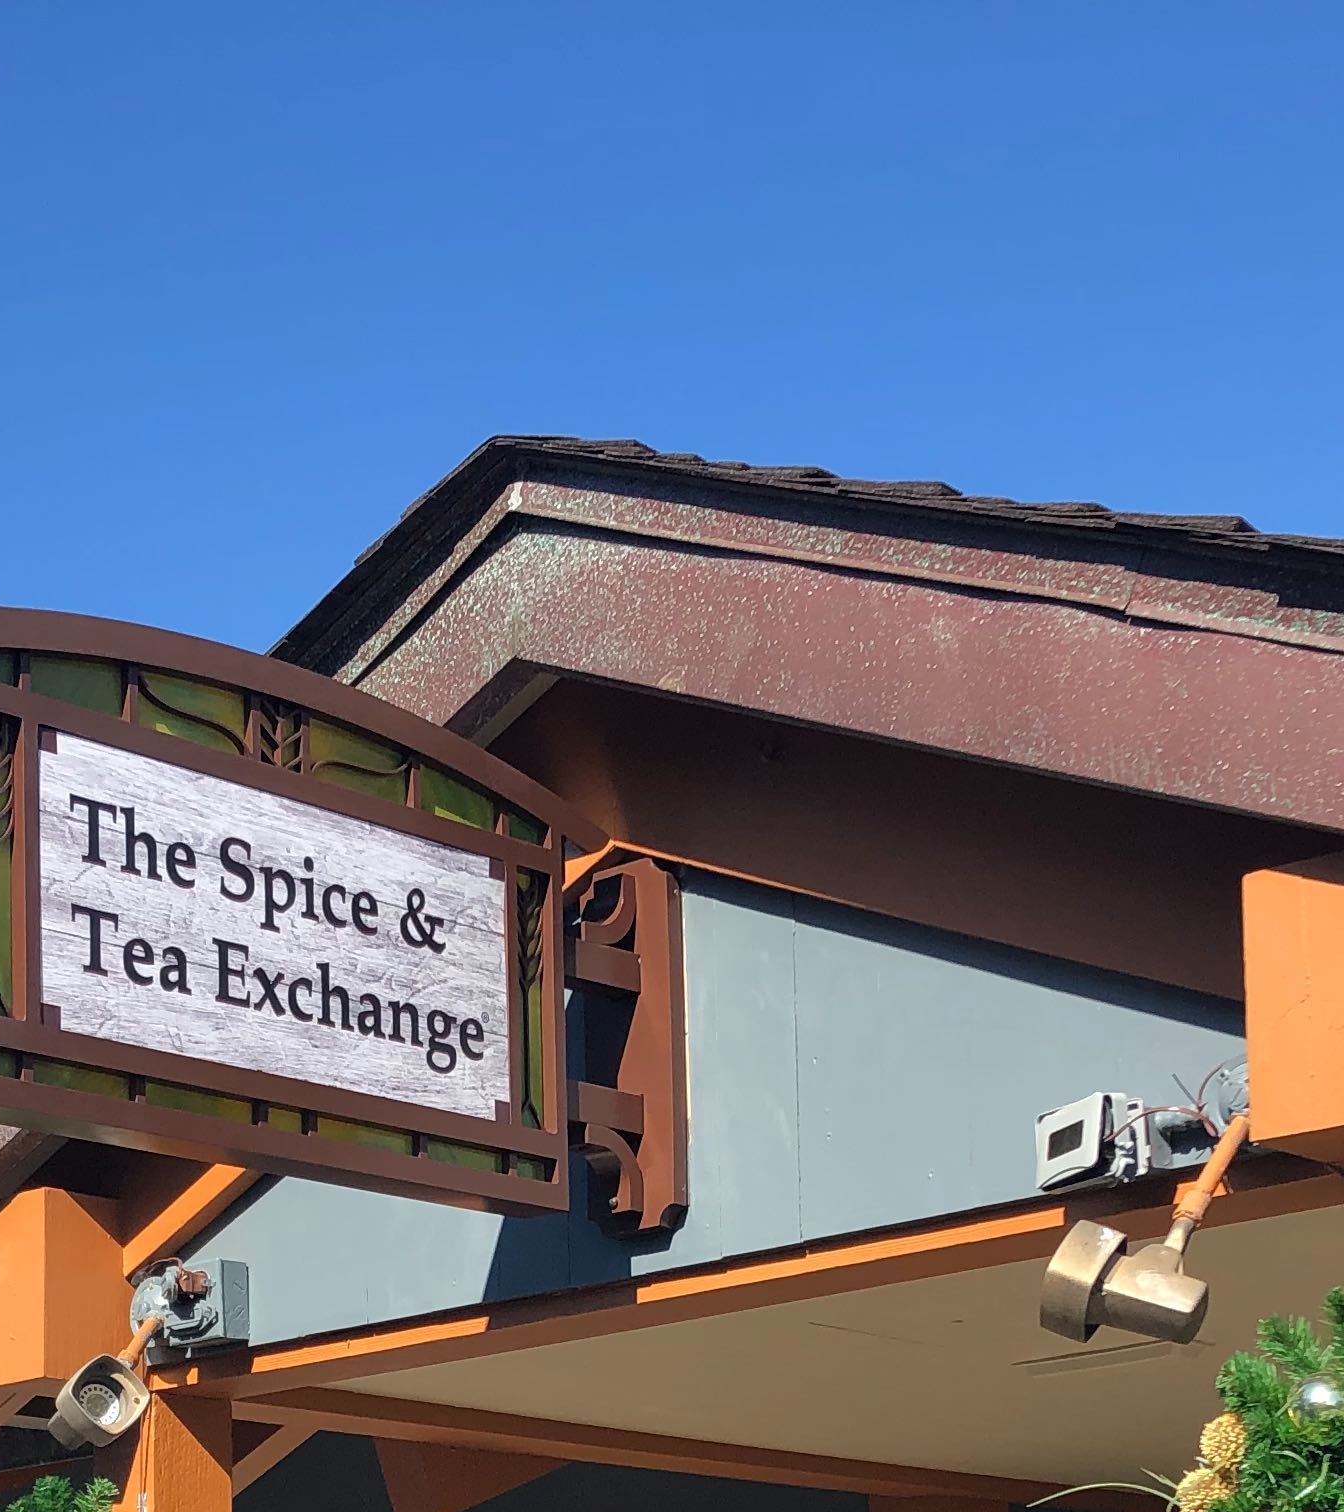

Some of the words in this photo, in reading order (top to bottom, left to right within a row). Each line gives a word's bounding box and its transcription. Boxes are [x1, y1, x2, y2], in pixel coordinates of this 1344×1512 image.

[69, 793, 197, 889] The
[219, 837, 379, 936] Spice
[399, 887, 447, 955] &
[70, 903, 193, 996] Tea
[212, 937, 486, 1075] Exchange
